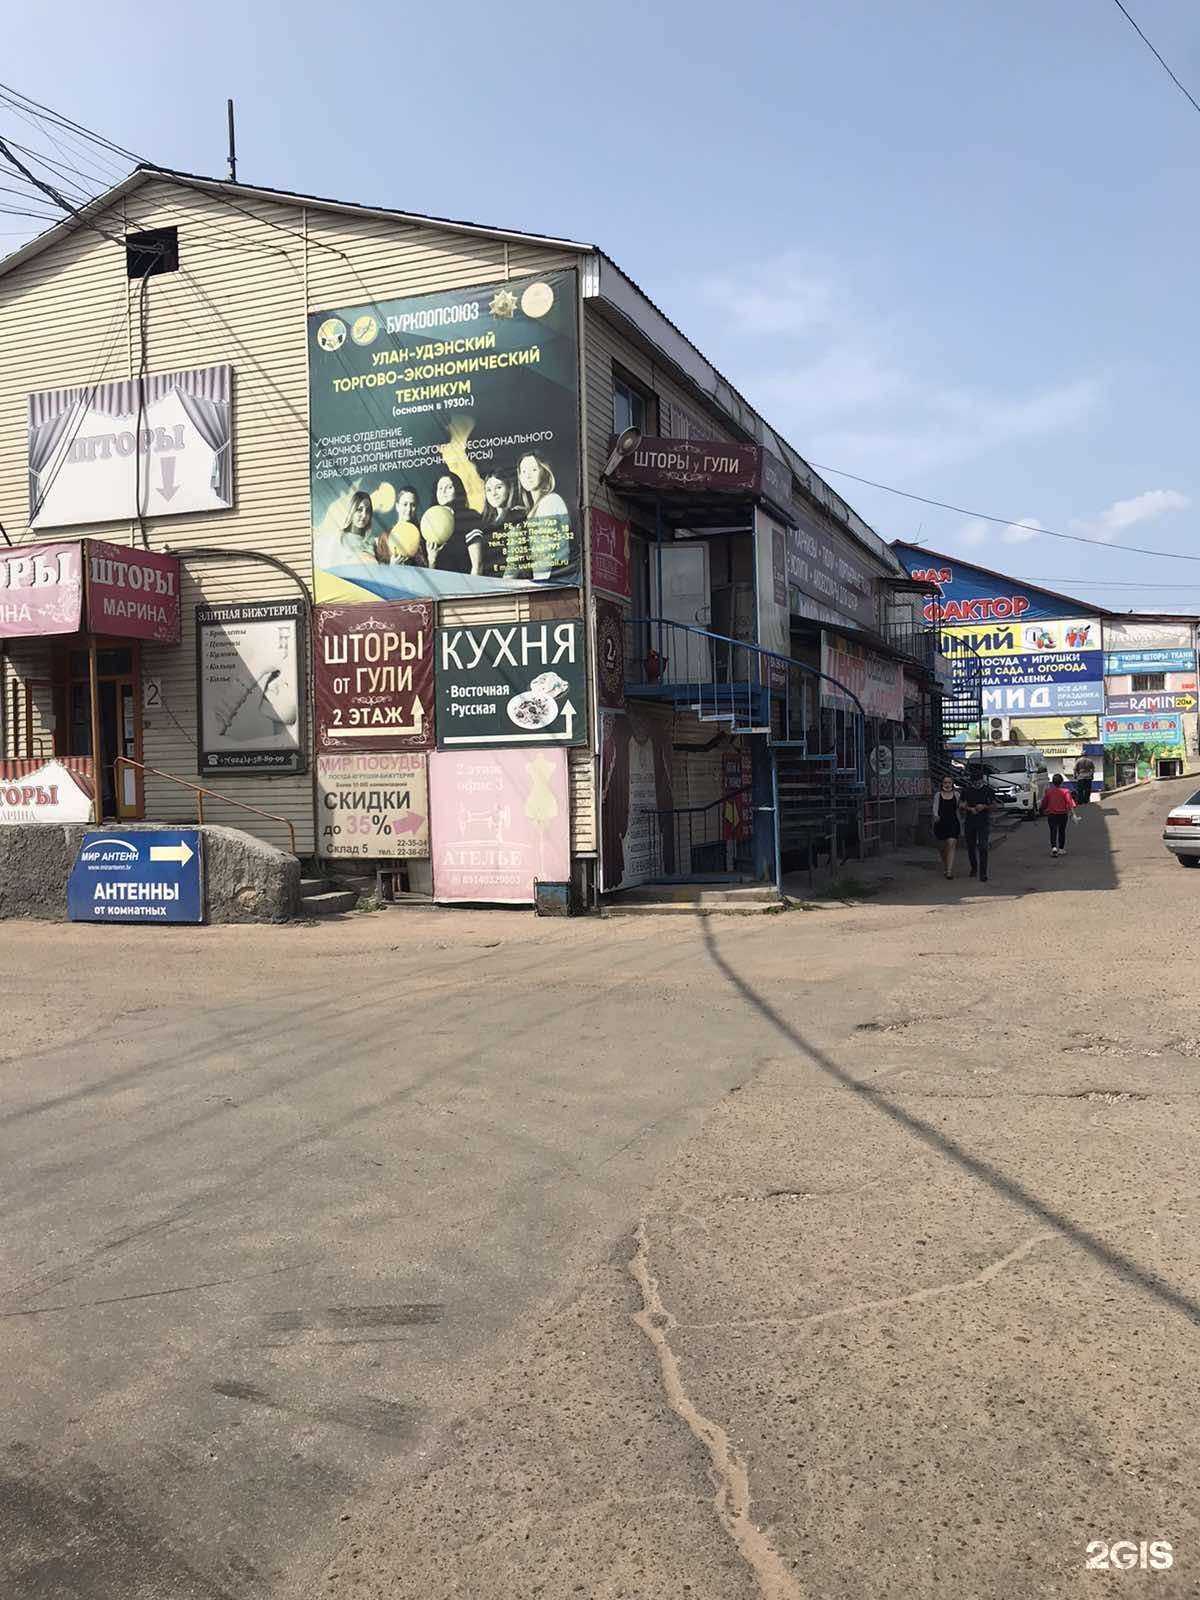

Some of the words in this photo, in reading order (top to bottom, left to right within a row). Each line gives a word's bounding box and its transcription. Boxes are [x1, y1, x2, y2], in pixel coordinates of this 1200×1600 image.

[386, 302, 480, 334] БУРКООПСОЮЗ
[371, 331, 496, 367] УЛАН-УДЭНСКИЙ
[333, 346, 541, 393] ТОРГОВО-ЭКОНОМИЧЕСКИЙ
[395, 380, 472, 404] ТЕХНИКУМ
[392, 403, 434, 417] (основан
[443, 395, 475, 409] 1930г.)
[67, 423, 186, 465] ШТОРЫ
[321, 434, 352, 447] ОЧНОЕ
[352, 427, 403, 442] ОТДЕЛЕНИЕ
[322, 444, 361, 457] ЗАОЧНОЕ
[363, 436, 413, 452] ОТДЕЛЕНИЕ
[322, 457, 349, 469] ЦЕНТР
[349, 444, 439, 466] ДОПОЛНИТЕЛЬНОГО
[634, 451, 689, 469] ШТОРЫ
[703, 456, 739, 474] ГУЛИ
[316, 464, 378, 480] ОБРАЗОВАНИЯ
[91, 558, 175, 596] ШТОРЫ
[103, 598, 168, 624] МАРИНА
[199, 609, 240, 621] ЭЛИТНАЯ
[242, 605, 298, 618] БИЖУТЕРИЯ
[924, 597, 1029, 621] ФАКТОР
[324, 630, 424, 665] ШТОРЫ
[442, 623, 575, 671] КУХНЯ
[977, 656, 1019, 667] ПОСУДА
[1032, 653, 1080, 663] ИГРУШКИ
[995, 666, 1024, 675] САДА
[1038, 663, 1087, 673] ОГОРОДА
[333, 678, 351, 695] от
[356, 665, 413, 693] ГУЛИ
[1012, 674, 1054, 684] КЛЕЕНКА
[147, 684, 159, 706] 2
[450, 684, 509, 698] Восточная
[981, 687, 1050, 710] МИД
[1130, 695, 1175, 709] RAMIN
[333, 708, 343, 726] 2
[349, 706, 403, 726] ЭТАЖ
[451, 703, 496, 717] Русская
[319, 757, 352, 772] МИР
[357, 755, 425, 771] ПОСУДЫ
[324, 791, 410, 813] СКИДКИ
[323, 825, 341, 837] до
[346, 815, 392, 835] 35%
[81, 853, 99, 861] МИР
[101, 852, 139, 861] АНТЕНН
[326, 844, 359, 855] Склад
[362, 844, 368, 854] 5
[443, 851, 521, 866] АТЕЛЬЕ
[94, 882, 179, 900] АНТЕННЫ
[108, 906, 167, 915] комнатных
